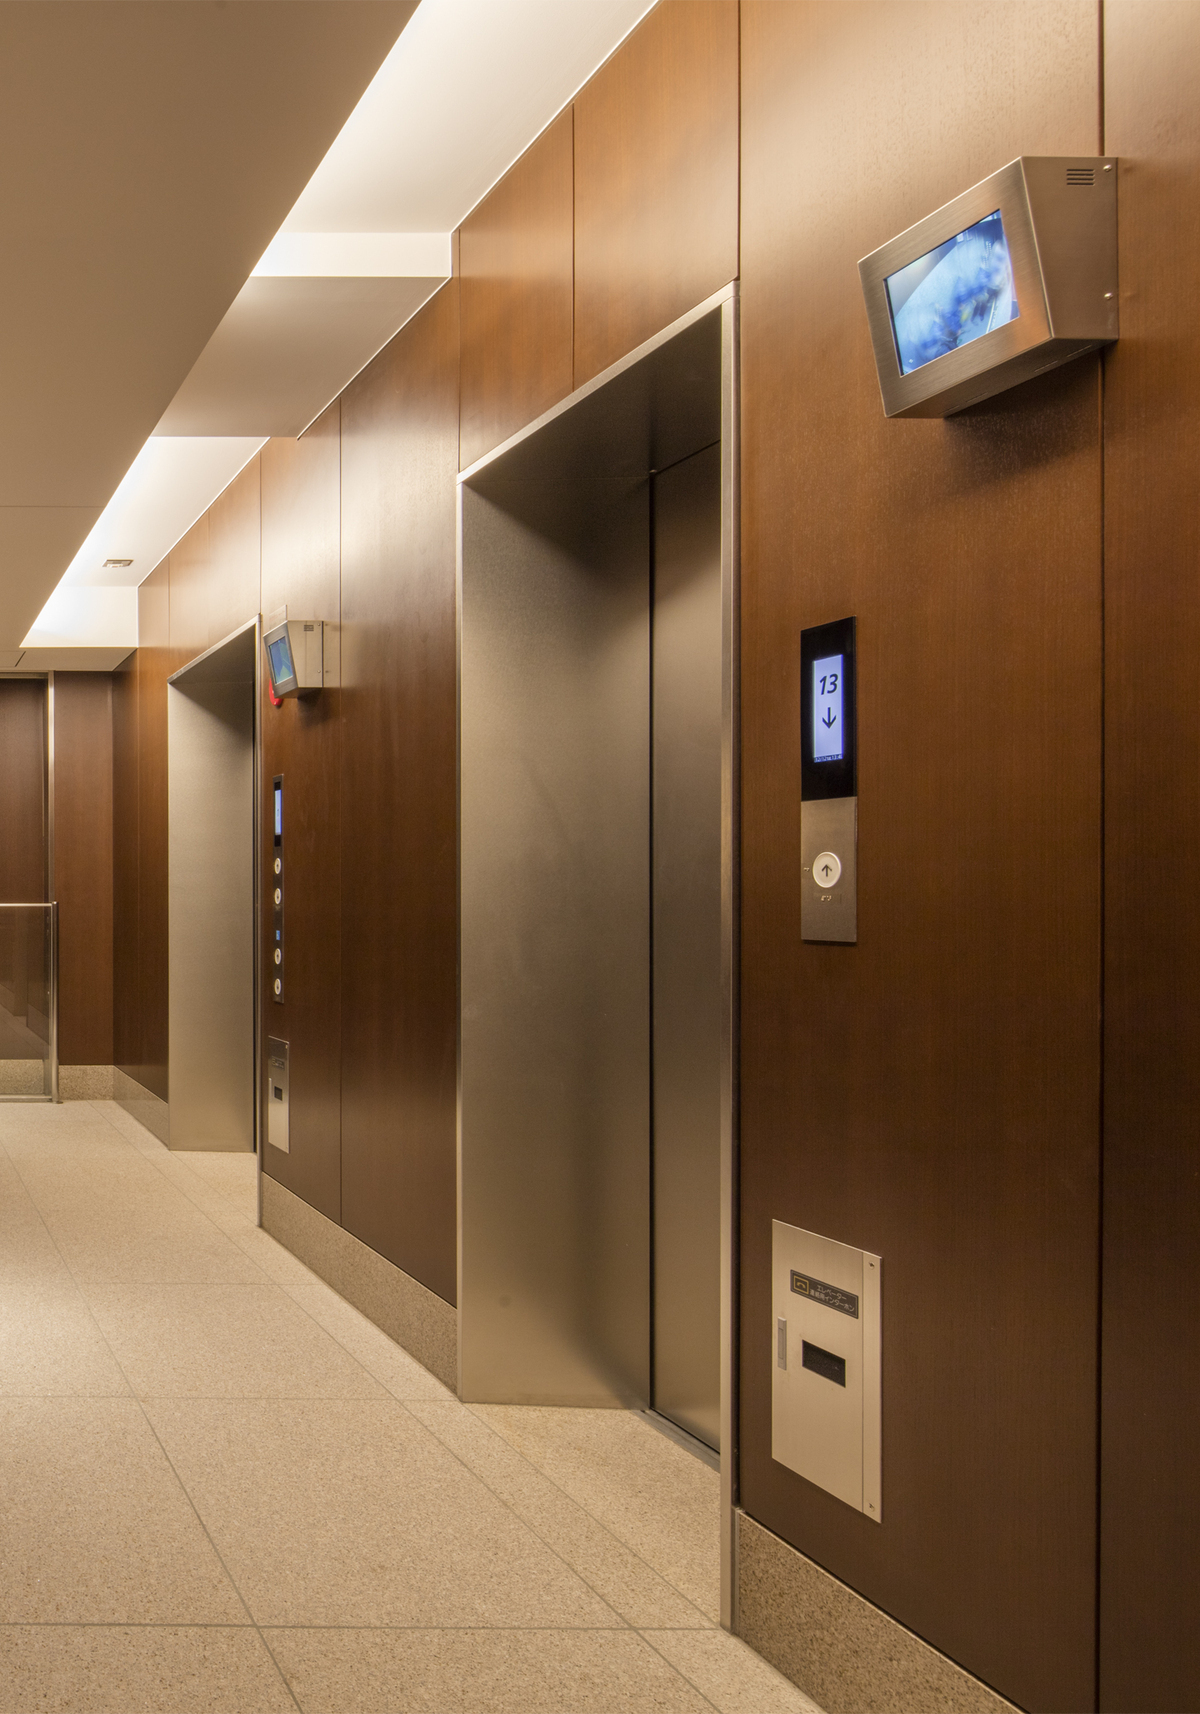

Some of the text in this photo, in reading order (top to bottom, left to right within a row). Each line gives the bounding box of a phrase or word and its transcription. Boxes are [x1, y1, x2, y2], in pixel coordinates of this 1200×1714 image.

[819, 673, 839, 695] 13
[816, 1285, 847, 1300] エレベーター
